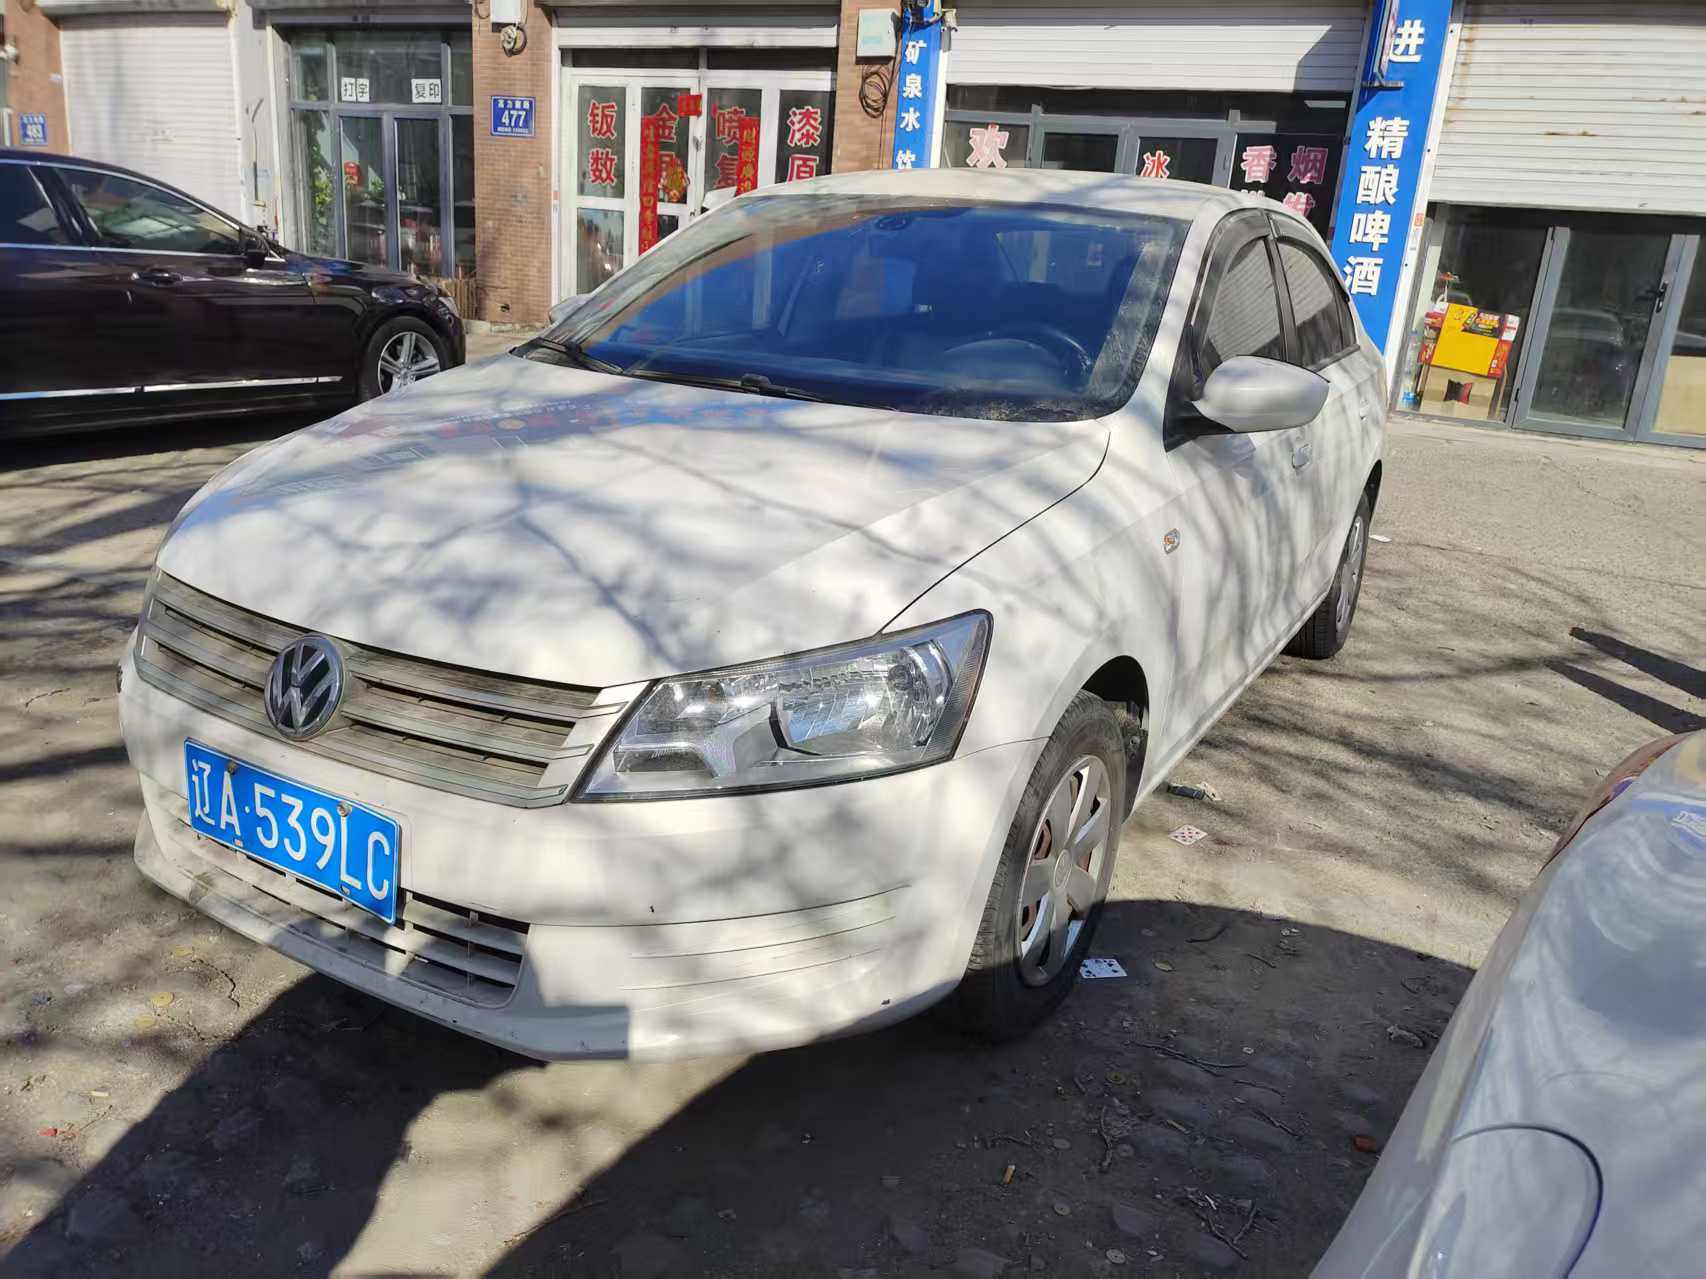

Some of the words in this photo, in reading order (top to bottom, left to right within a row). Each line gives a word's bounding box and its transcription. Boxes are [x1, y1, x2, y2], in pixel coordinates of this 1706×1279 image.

[343, 81, 368, 98] 打字
[414, 81, 441, 99] 复印
[899, 39, 928, 132] 矿泉水
[501, 109, 527, 127] 477
[965, 122, 1010, 169] 欢
[1239, 144, 1329, 184] 香烟
[1343, 116, 1411, 297] 精酿啤酒
